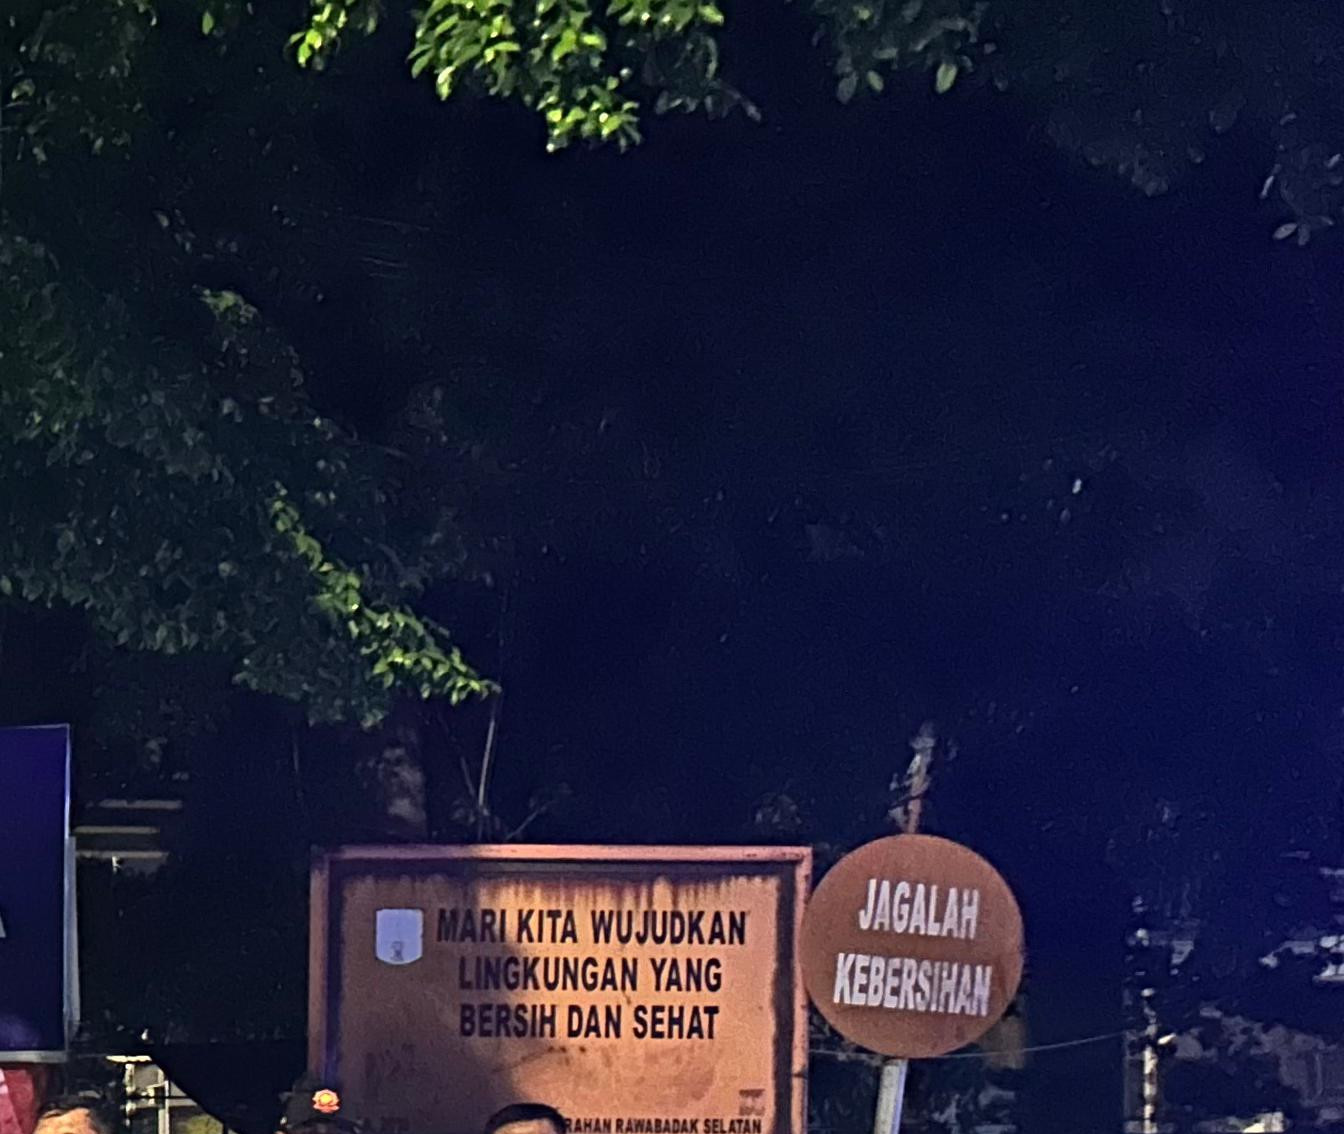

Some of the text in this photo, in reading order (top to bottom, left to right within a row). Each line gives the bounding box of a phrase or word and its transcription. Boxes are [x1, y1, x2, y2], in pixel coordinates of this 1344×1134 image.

[858, 878, 980, 940] JAGALAH
[436, 909, 747, 946] MARI KITA WUJUDKAN
[459, 957, 723, 993] LINGKUNGAN YANG
[833, 952, 993, 1017] KEBERSIHAN
[460, 1004, 720, 1040] BERSIH DAN SEHAT
[564, 1117, 762, 1134] RAHAN RAWABADAK SELATAN
